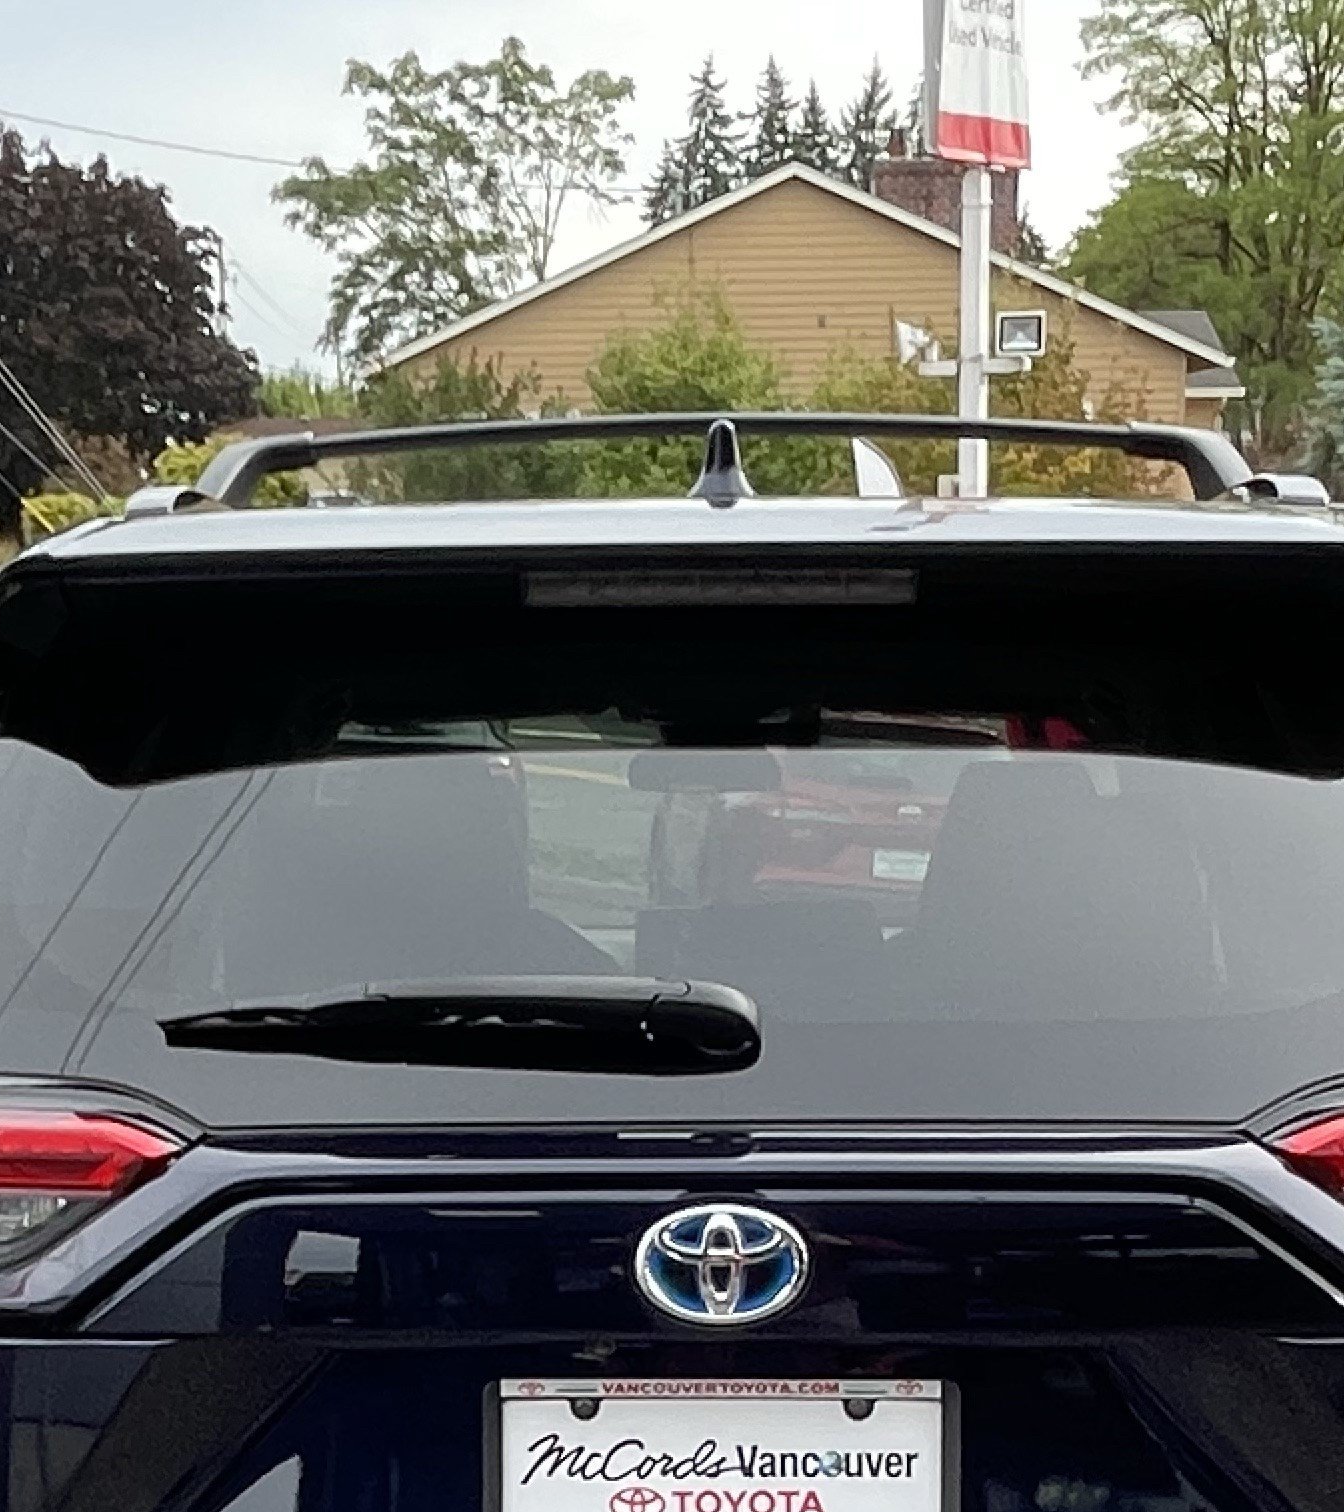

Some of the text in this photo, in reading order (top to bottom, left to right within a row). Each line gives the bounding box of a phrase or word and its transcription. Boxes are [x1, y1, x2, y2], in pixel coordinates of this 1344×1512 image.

[602, 1382, 840, 1394] VANCOUVERTOYOTA.COM
[521, 1433, 920, 1485] McCords Vancouver
